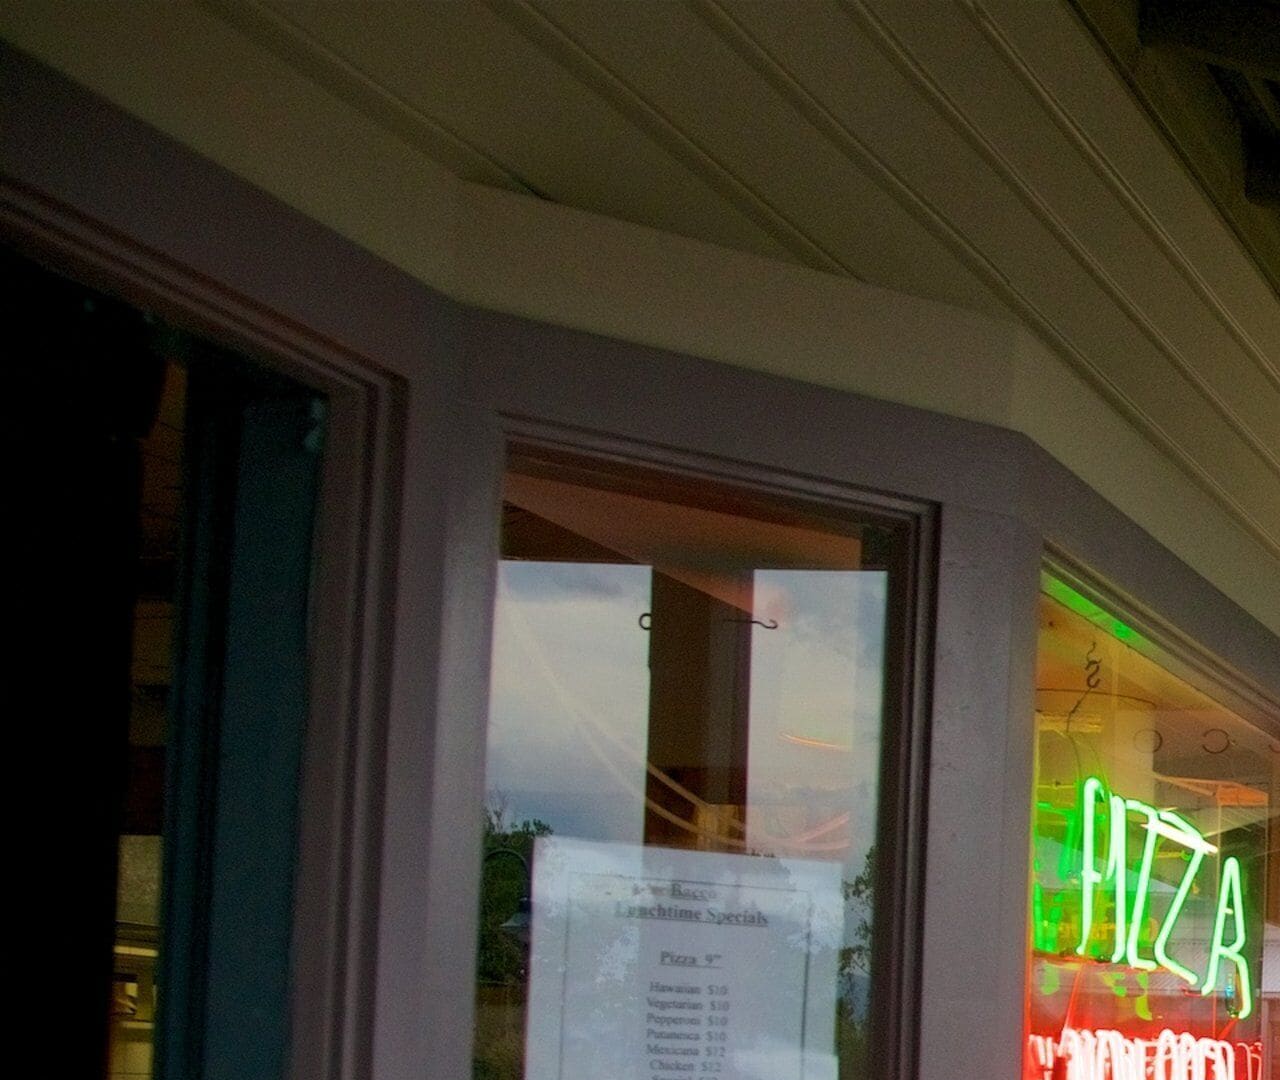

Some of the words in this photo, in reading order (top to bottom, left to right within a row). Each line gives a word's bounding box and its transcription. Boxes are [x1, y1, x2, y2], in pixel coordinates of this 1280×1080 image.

[1077, 777, 1252, 1018] PIZZA
[614, 901, 702, 921] Lunchtime
[706, 907, 769, 927] Specials
[660, 951, 697, 965] Pizza
